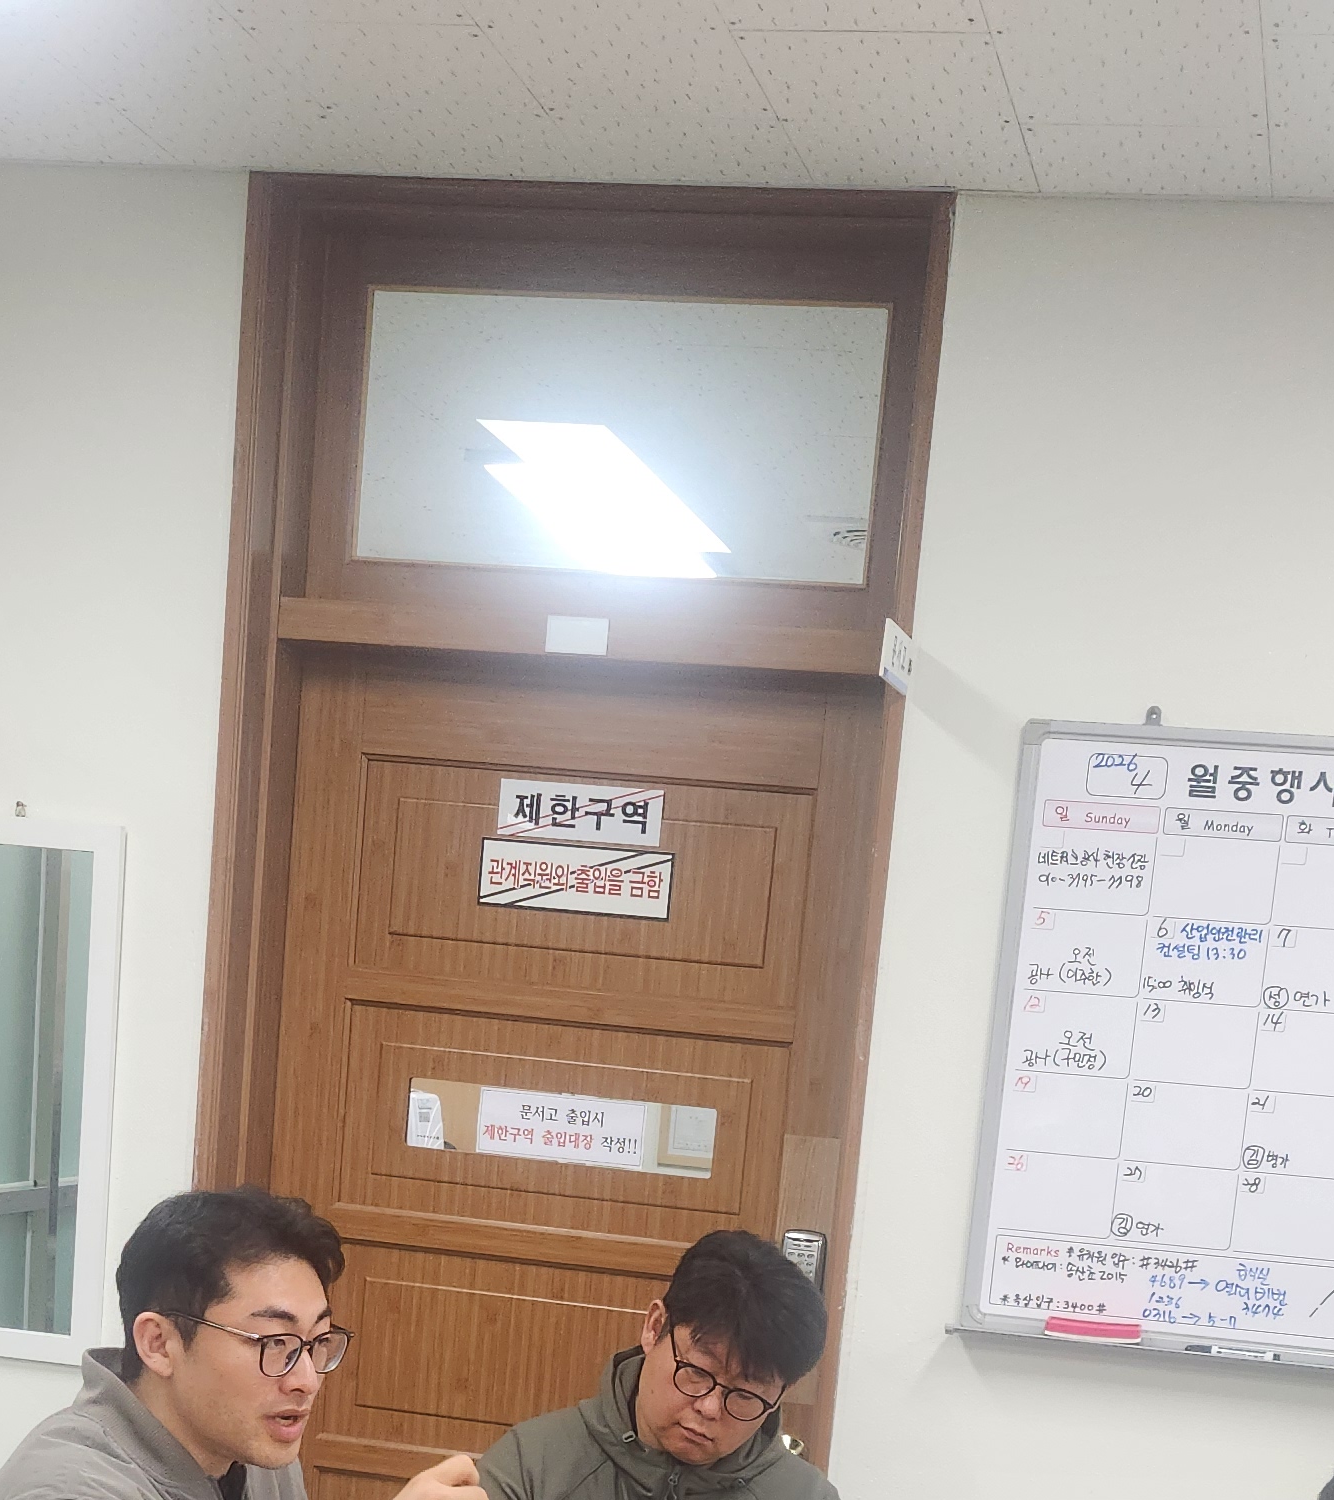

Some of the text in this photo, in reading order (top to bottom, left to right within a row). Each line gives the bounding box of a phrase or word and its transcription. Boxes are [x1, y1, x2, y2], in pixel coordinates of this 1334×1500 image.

[1093, 753, 1137, 772] 2026
[1130, 770, 1153, 794] 4
[514, 793, 650, 834] 제한구역
[1055, 805, 1131, 828] 일 Sunday
[1175, 813, 1254, 836] 월 Monday
[1297, 820, 1313, 834] 화
[488, 858, 663, 899] 관계직원외 출입을 금함
[1035, 910, 1049, 926] 5
[1157, 918, 1263, 944] 6 산업안전관리
[1277, 928, 1291, 948] 7
[1067, 947, 1097, 966] 오전
[1157, 943, 1247, 960] 컨설팅 13:30
[1143, 976, 1215, 1000] 15:00 취임식
[1024, 995, 1041, 1011] 12
[1293, 990, 1331, 1007] 연가
[1143, 1003, 1161, 1020] 13
[1263, 1012, 1283, 1031] 14
[1059, 1030, 1095, 1051] 오전
[1015, 1076, 1031, 1090] 19
[1133, 1086, 1152, 1098] 20
[1251, 1095, 1269, 1110] 21
[519, 1104, 605, 1128] 문서고 출입시
[482, 1124, 639, 1156] 제한구역 출입대장 작성!!
[1007, 1155, 1025, 1170] 26
[1123, 1166, 1142, 1180] 27
[1242, 1177, 1261, 1192] 28
[1135, 1221, 1165, 1237] 연가
[1007, 1242, 1059, 1258] Remarks
[1149, 1274, 1185, 1290] 4689
